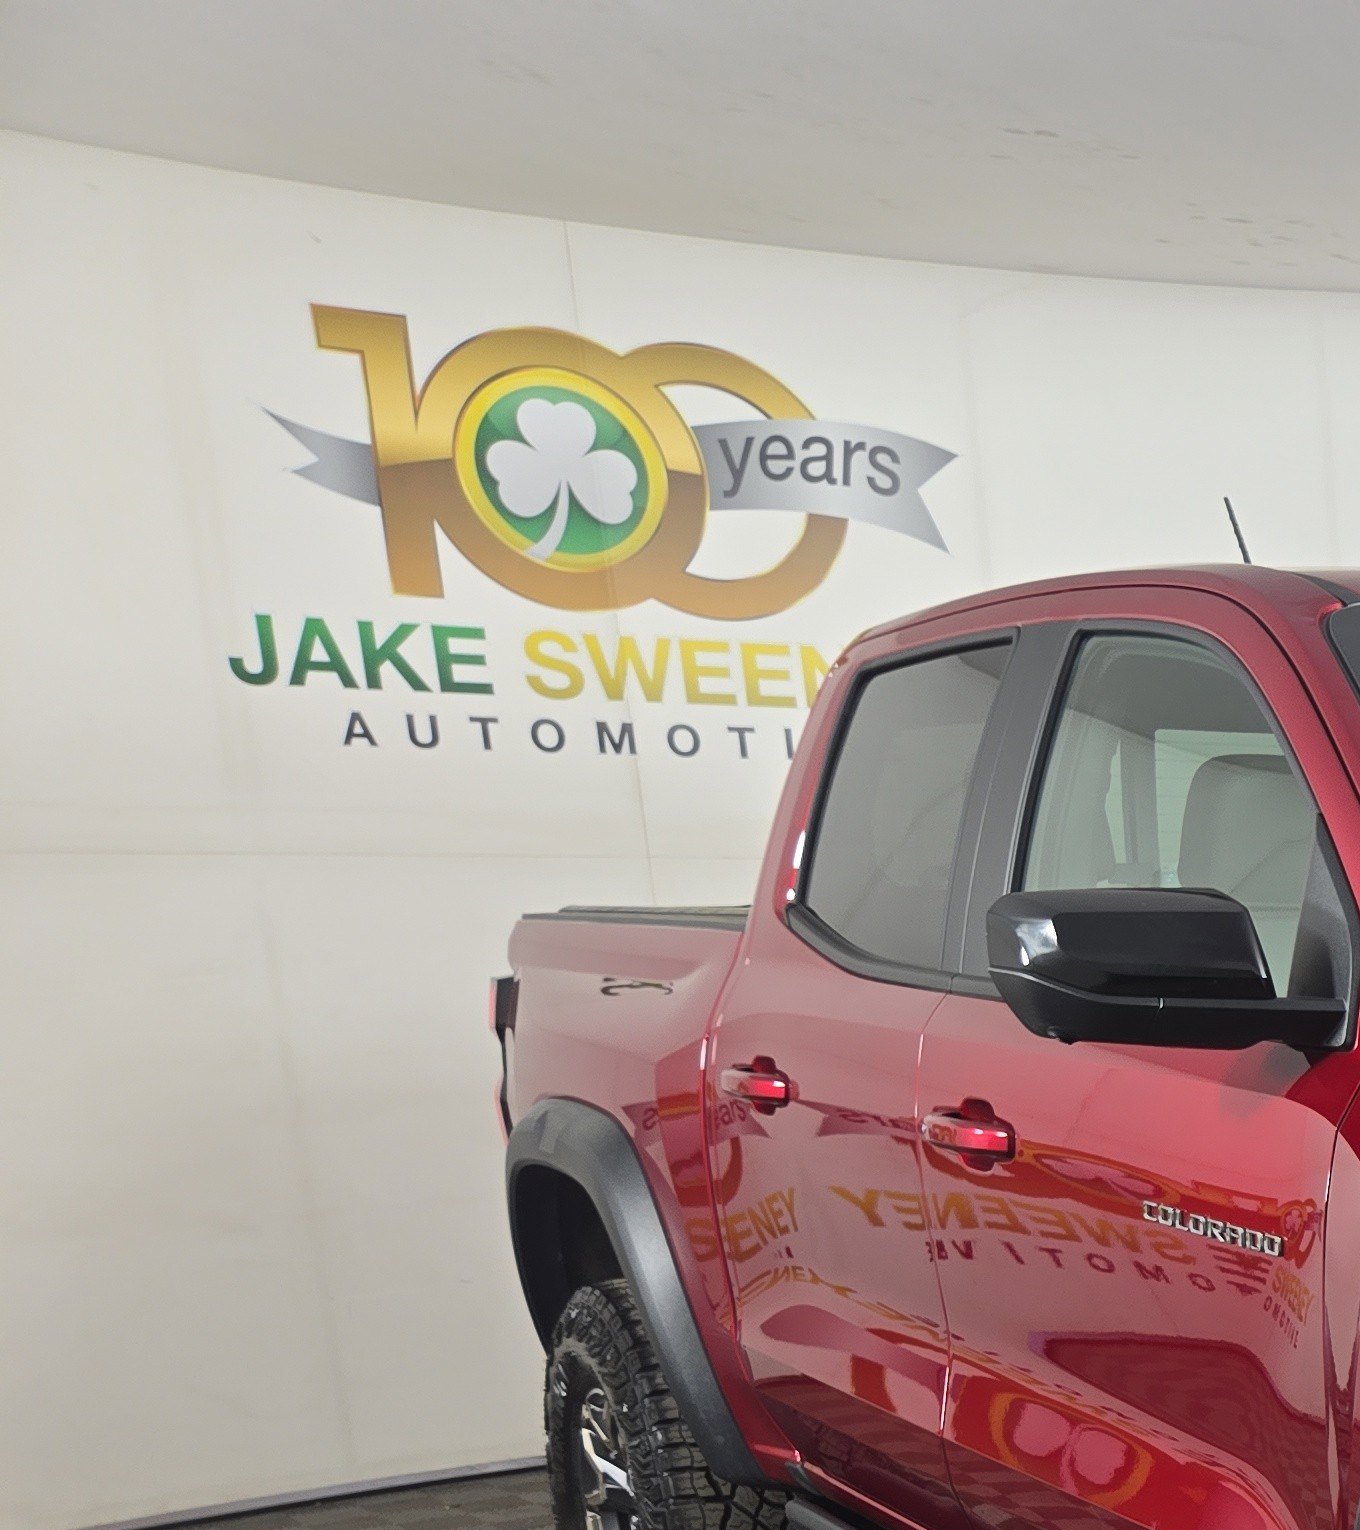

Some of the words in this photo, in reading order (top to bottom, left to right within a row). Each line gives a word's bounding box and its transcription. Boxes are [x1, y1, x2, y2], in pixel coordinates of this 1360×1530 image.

[310, 302, 850, 622] 100
[718, 430, 903, 500] years
[228, 614, 494, 696] JAKE
[523, 630, 848, 709] SWEEN
[343, 711, 795, 761] AUTOMOTI
[1142, 1200, 1287, 1257] COLORADO
